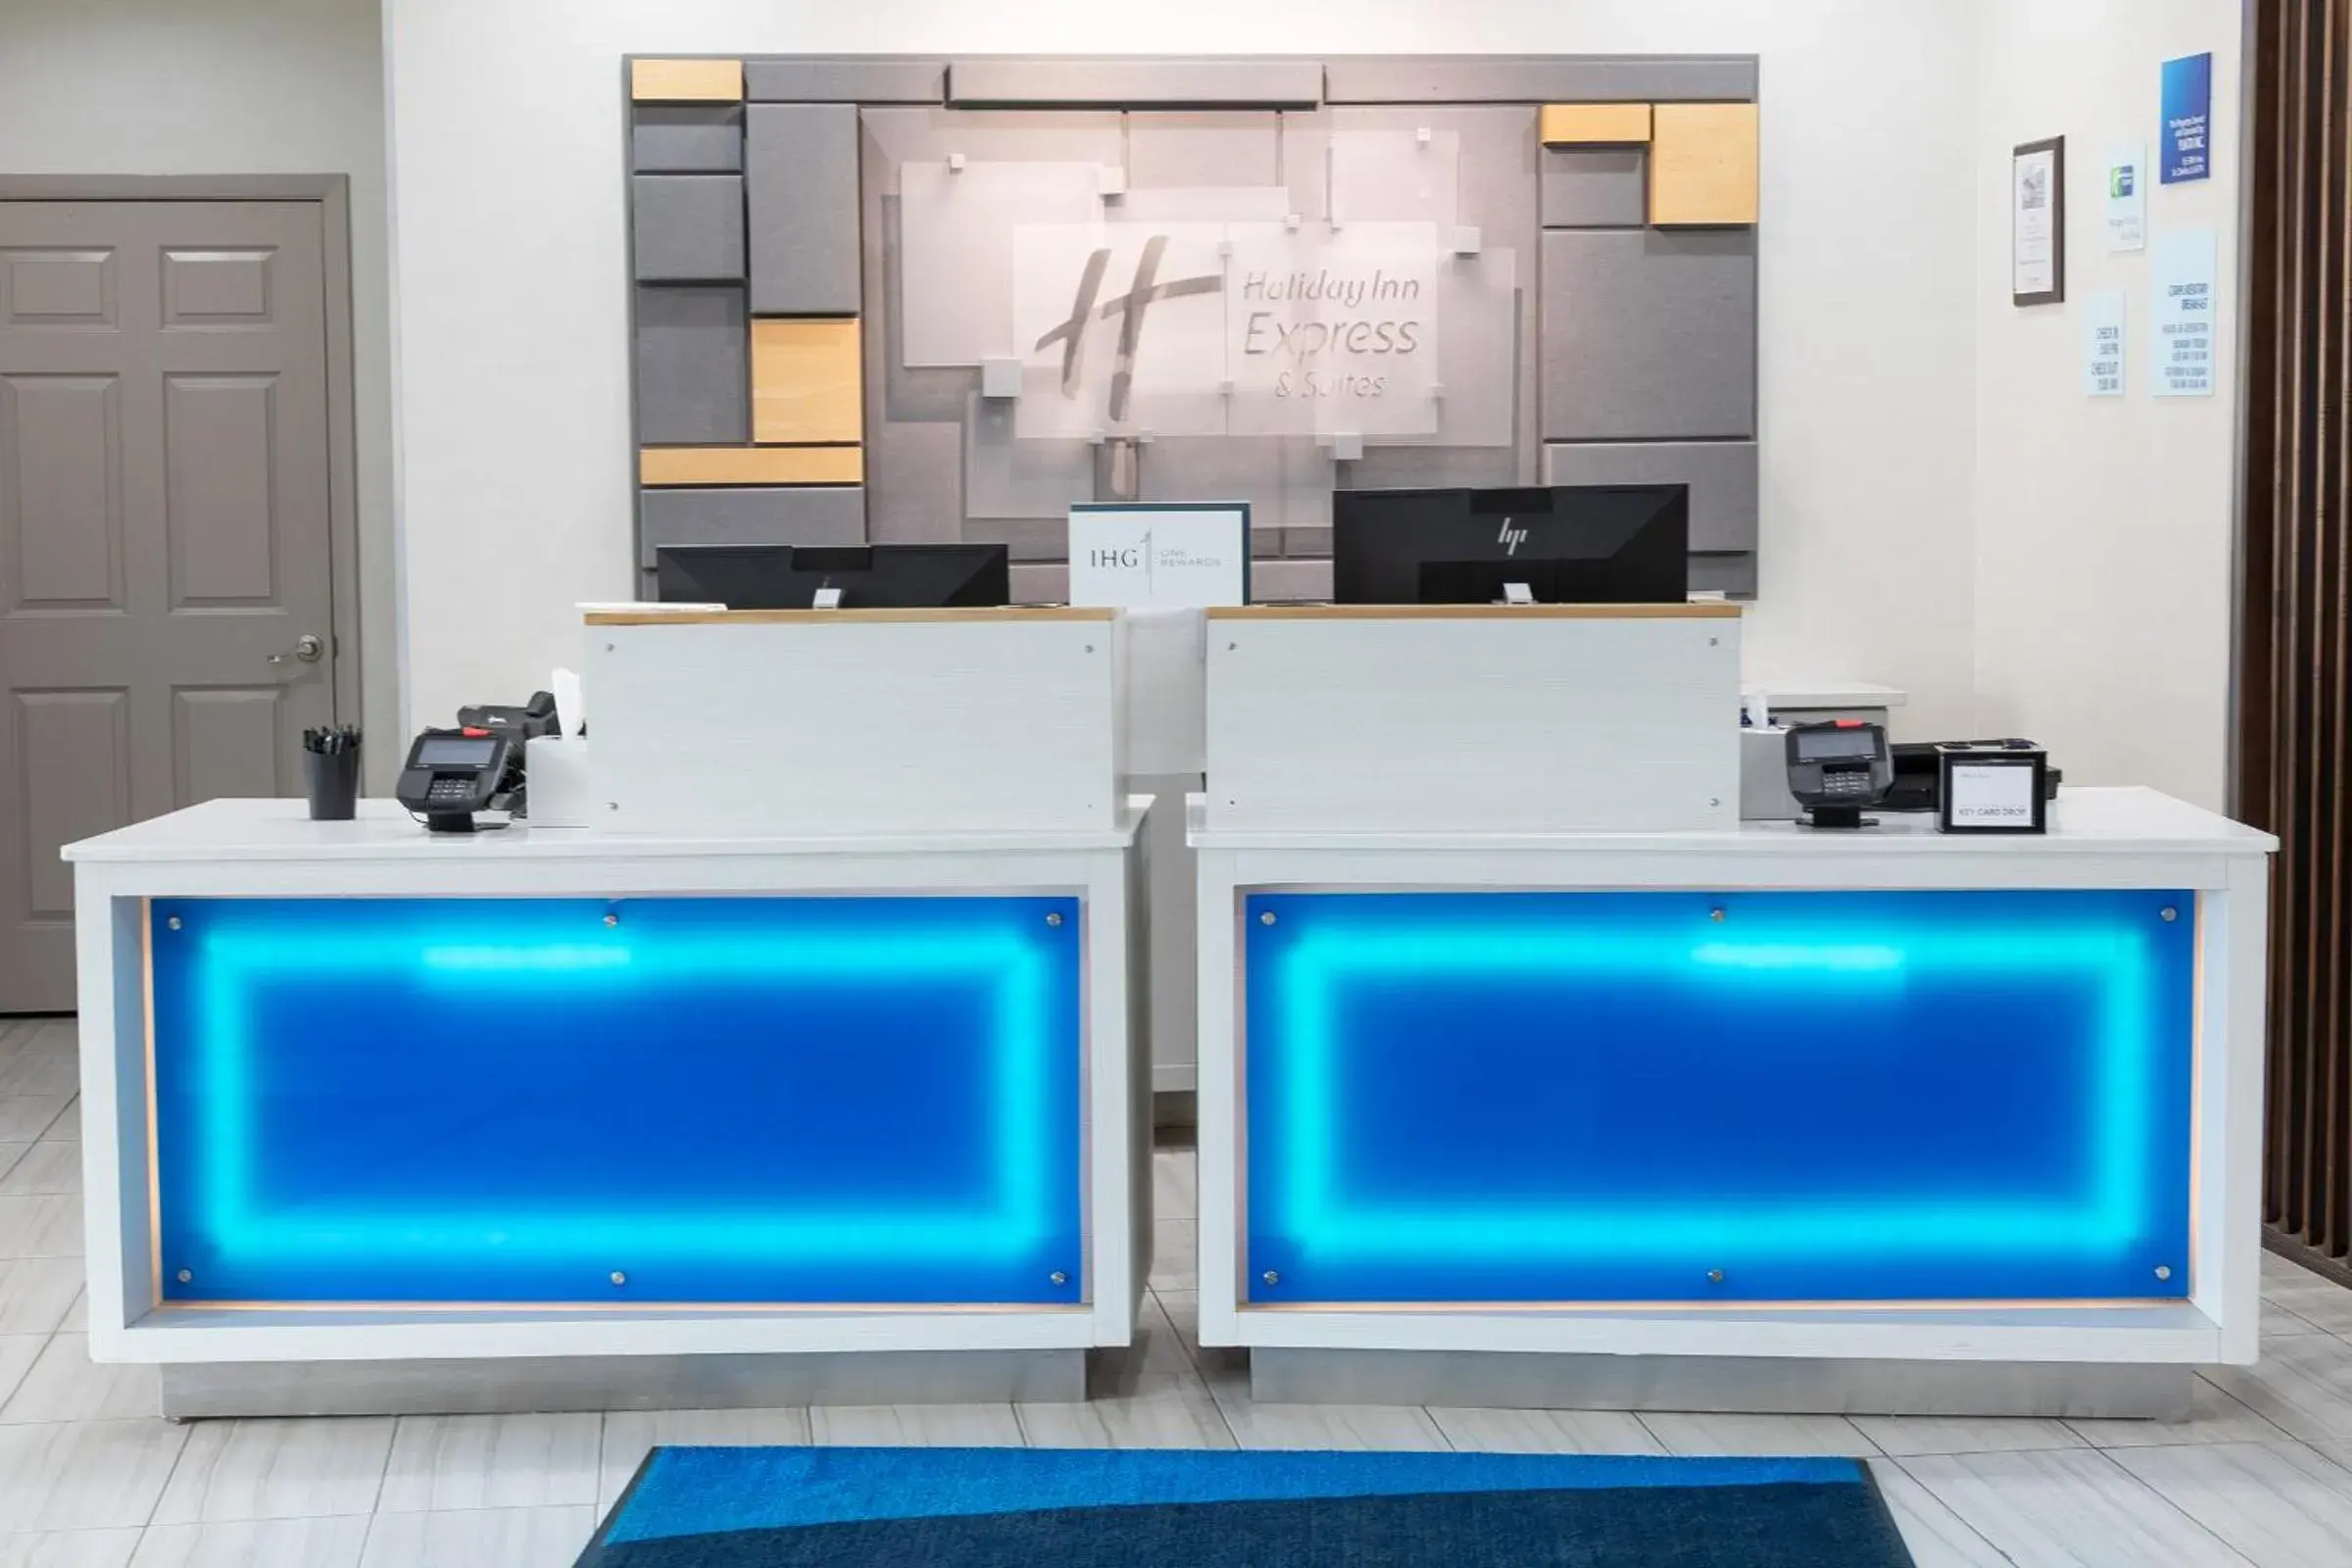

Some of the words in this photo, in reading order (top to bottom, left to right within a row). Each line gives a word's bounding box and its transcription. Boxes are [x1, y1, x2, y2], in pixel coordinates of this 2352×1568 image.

[1243, 269, 1364, 308] Holiday
[1372, 270, 1420, 301] Inn
[1243, 311, 1420, 364] Express
[1275, 370, 1293, 398] &
[1300, 370, 1389, 398] Suites
[1497, 516, 1528, 556] hp
[1091, 549, 1138, 567] IHG
[1977, 808, 2000, 816] CARD
